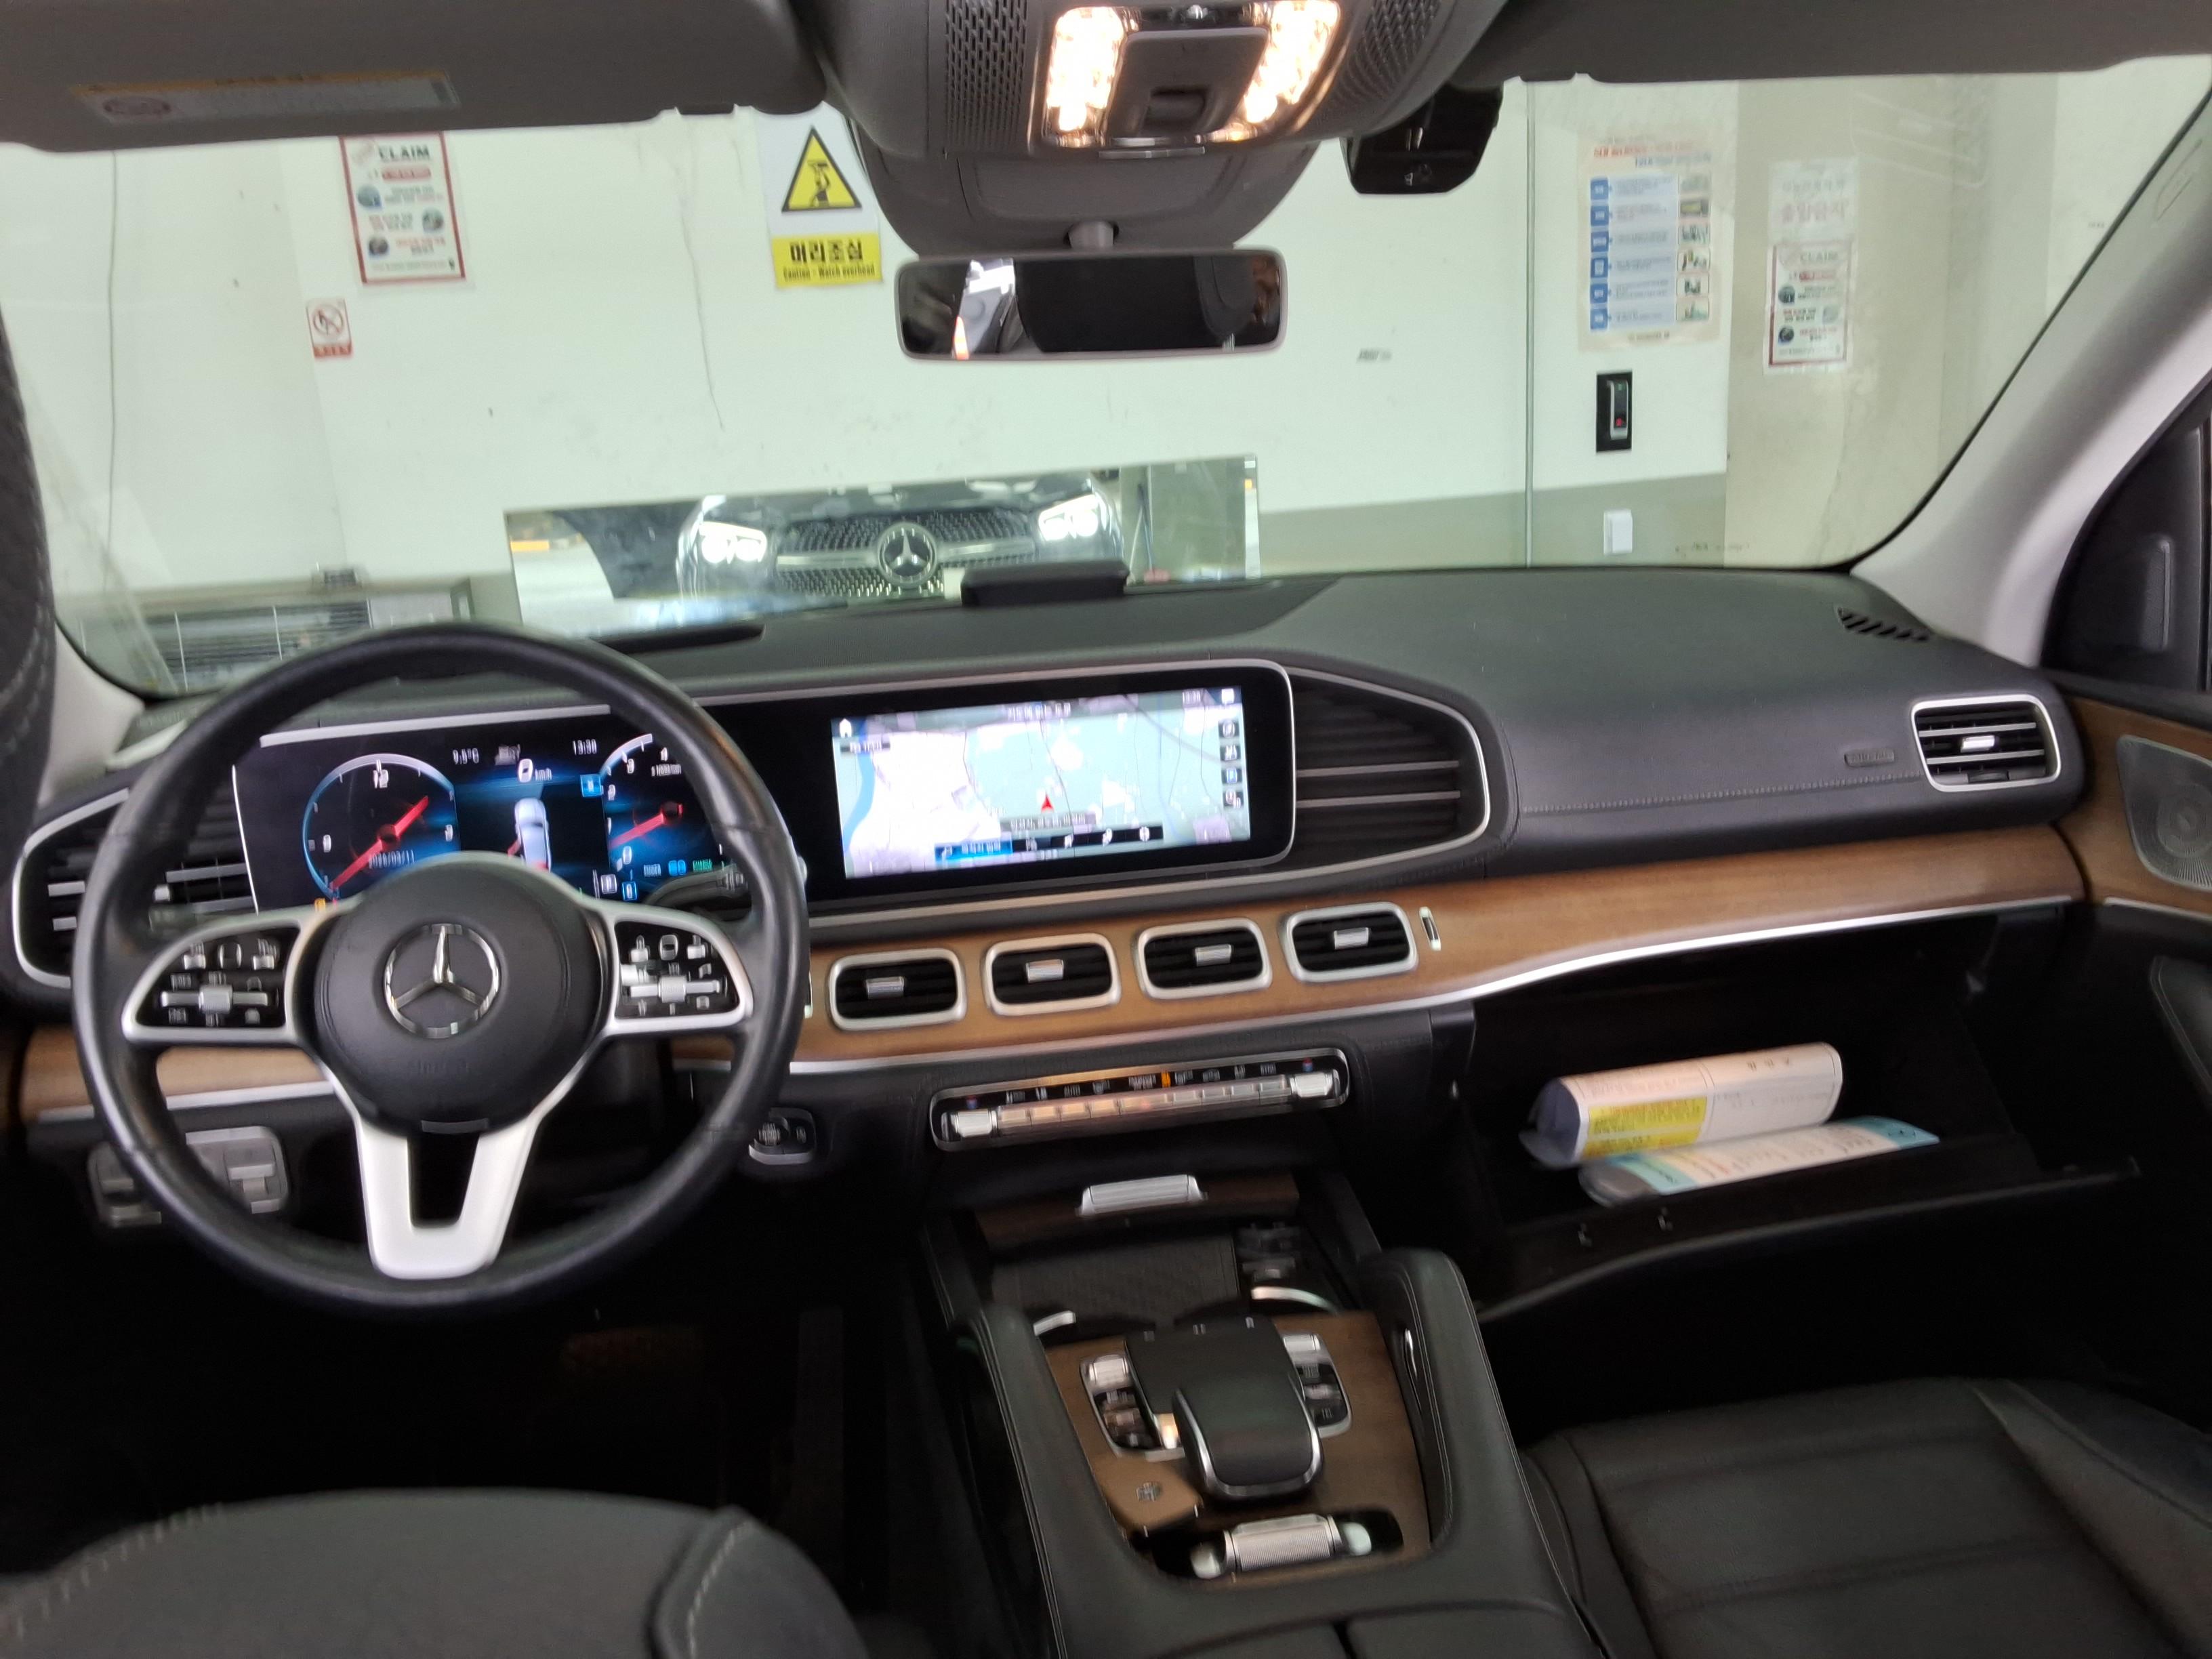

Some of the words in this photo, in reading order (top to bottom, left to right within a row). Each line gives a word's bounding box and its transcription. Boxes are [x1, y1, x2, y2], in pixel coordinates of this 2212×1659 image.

[379, 144, 430, 163] CLAIM
[790, 238, 863, 263] 머리조심
[783, 266, 811, 281] Caution
[818, 264, 840, 279] Watch
[842, 262, 876, 278] overhead
[518, 758, 533, 783] 0
